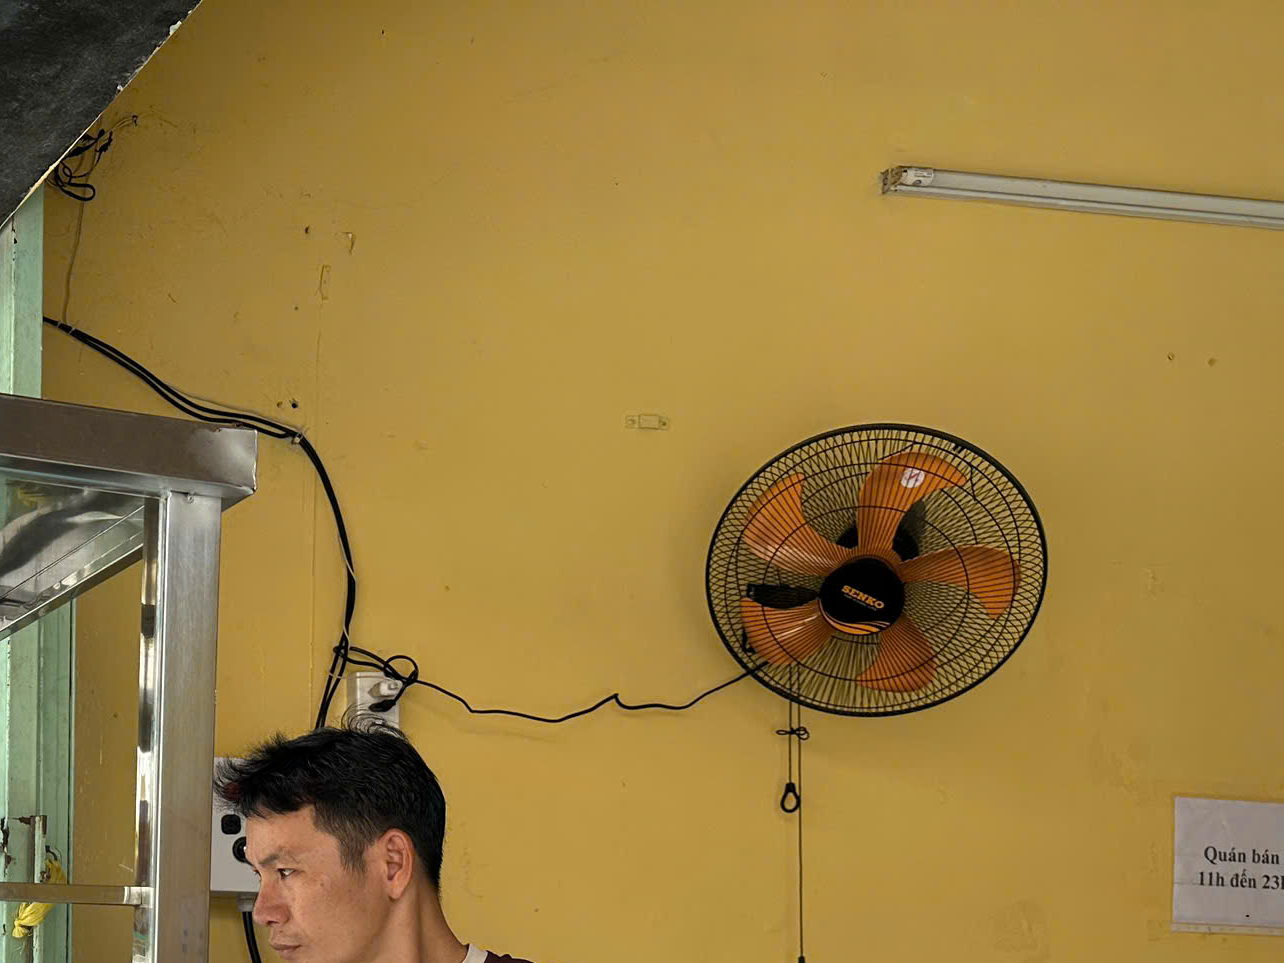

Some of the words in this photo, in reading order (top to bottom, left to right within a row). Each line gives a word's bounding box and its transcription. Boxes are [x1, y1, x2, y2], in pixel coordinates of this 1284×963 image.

[841, 585, 884, 609] SENKO
[1204, 846, 1246, 865] Quán
[1252, 849, 1279, 865] bán
[1199, 871, 1224, 887] 11h
[1230, 869, 1256, 888] đến
